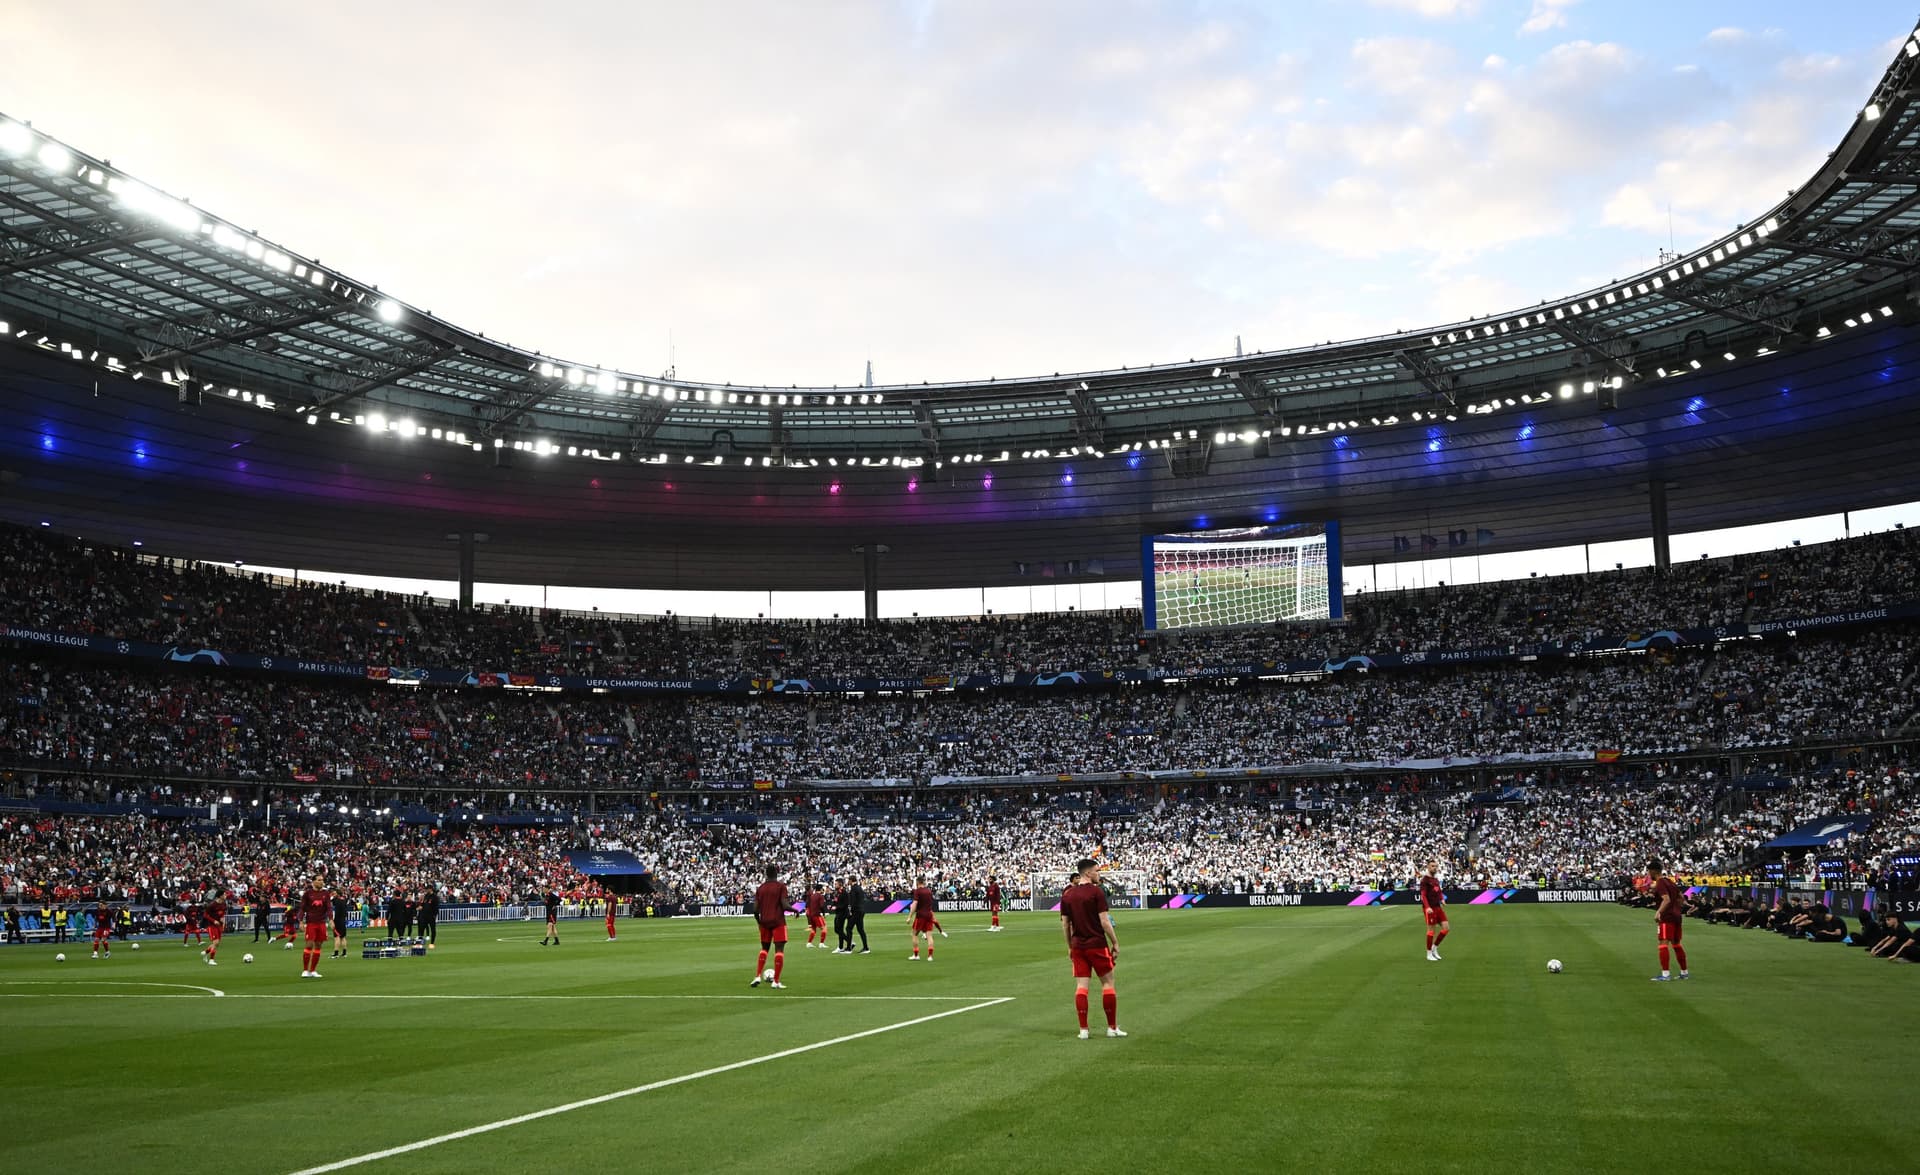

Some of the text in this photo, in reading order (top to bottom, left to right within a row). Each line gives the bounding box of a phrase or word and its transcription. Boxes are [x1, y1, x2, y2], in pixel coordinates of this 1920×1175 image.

[1785, 614, 1845, 629] CHAMPIONS
[1848, 608, 1888, 621] LEAGUE
[1, 627, 89, 647] HAMPIONS LEAGUE
[1440, 652, 1470, 660] PARIS
[1473, 649, 1507, 657] FINAL
[298, 662, 326, 672] PARIS
[328, 664, 364, 675] FINALE
[586, 679, 693, 689] UEFA CHAMPIONS LEAGUE
[879, 680, 905, 688] PARIS
[1249, 894, 1302, 906] UEFA.COM/PLAY
[1538, 890, 1563, 902] WHERE
[1563, 890, 1600, 901] FOOTBALL
[700, 905, 744, 916] UEFA.COM/PLAY
[938, 901, 959, 911] WHERE
